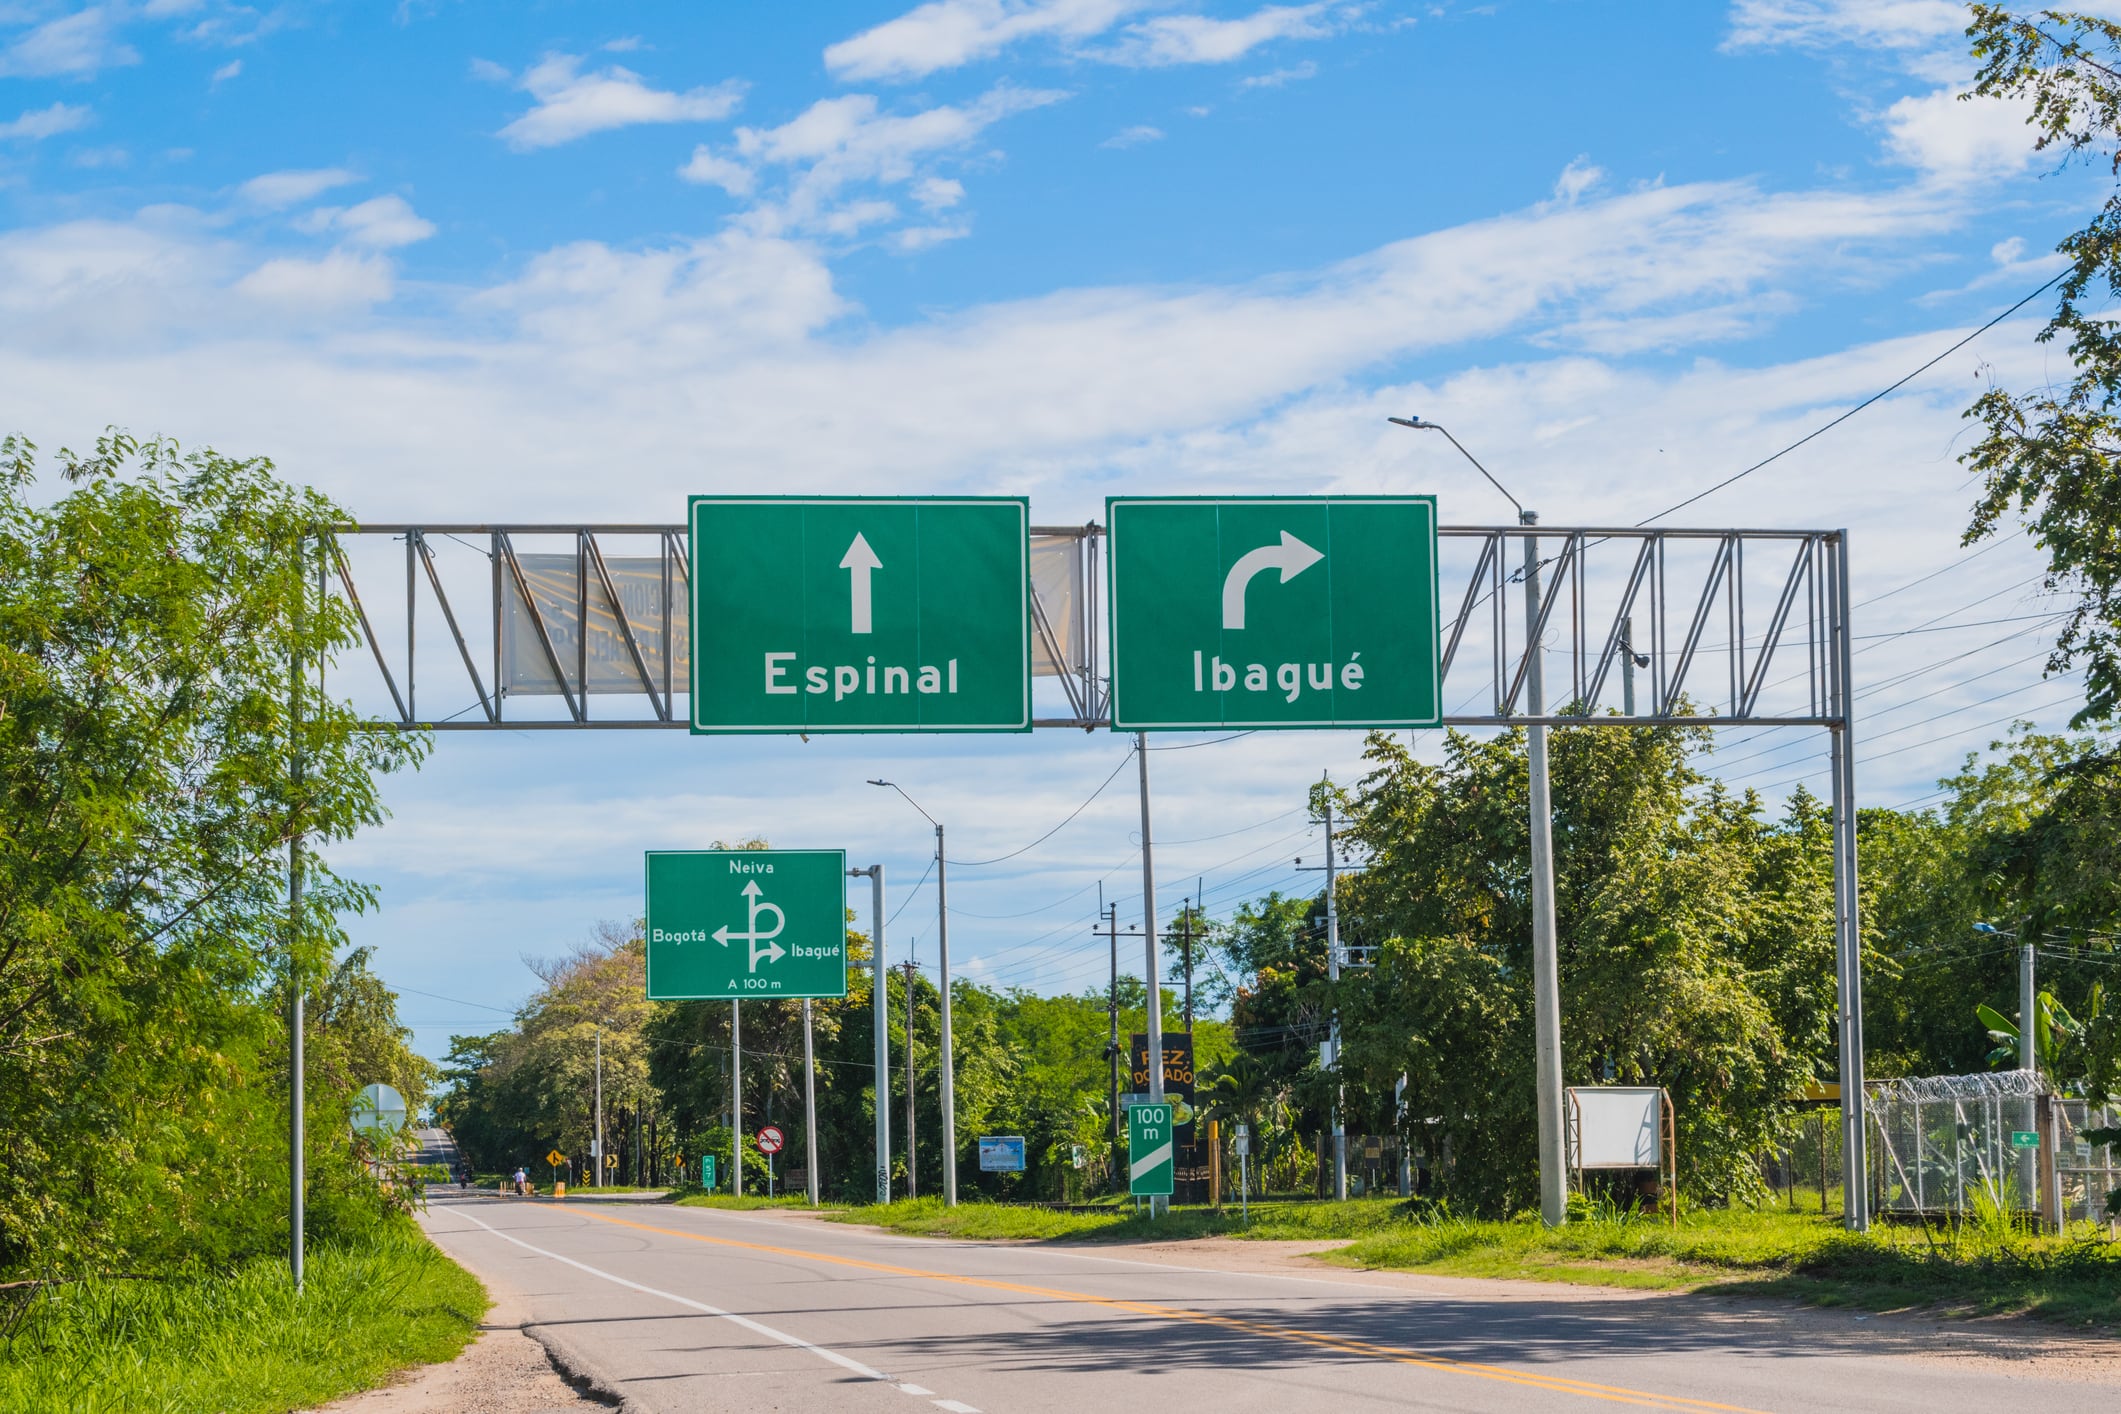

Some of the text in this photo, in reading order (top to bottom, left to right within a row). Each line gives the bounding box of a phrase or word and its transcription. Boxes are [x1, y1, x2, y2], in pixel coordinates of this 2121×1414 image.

[764, 651, 958, 703] Espinal
[1193, 650, 1365, 704] Ibagué
[729, 859, 774, 874] Neiva
[652, 928, 706, 945] Bogotá
[791, 943, 840, 960] Ibagué
[728, 978, 782, 990] A 100 m
[1136, 1108, 1165, 1124] 100
[1143, 1127, 1159, 1140] m
